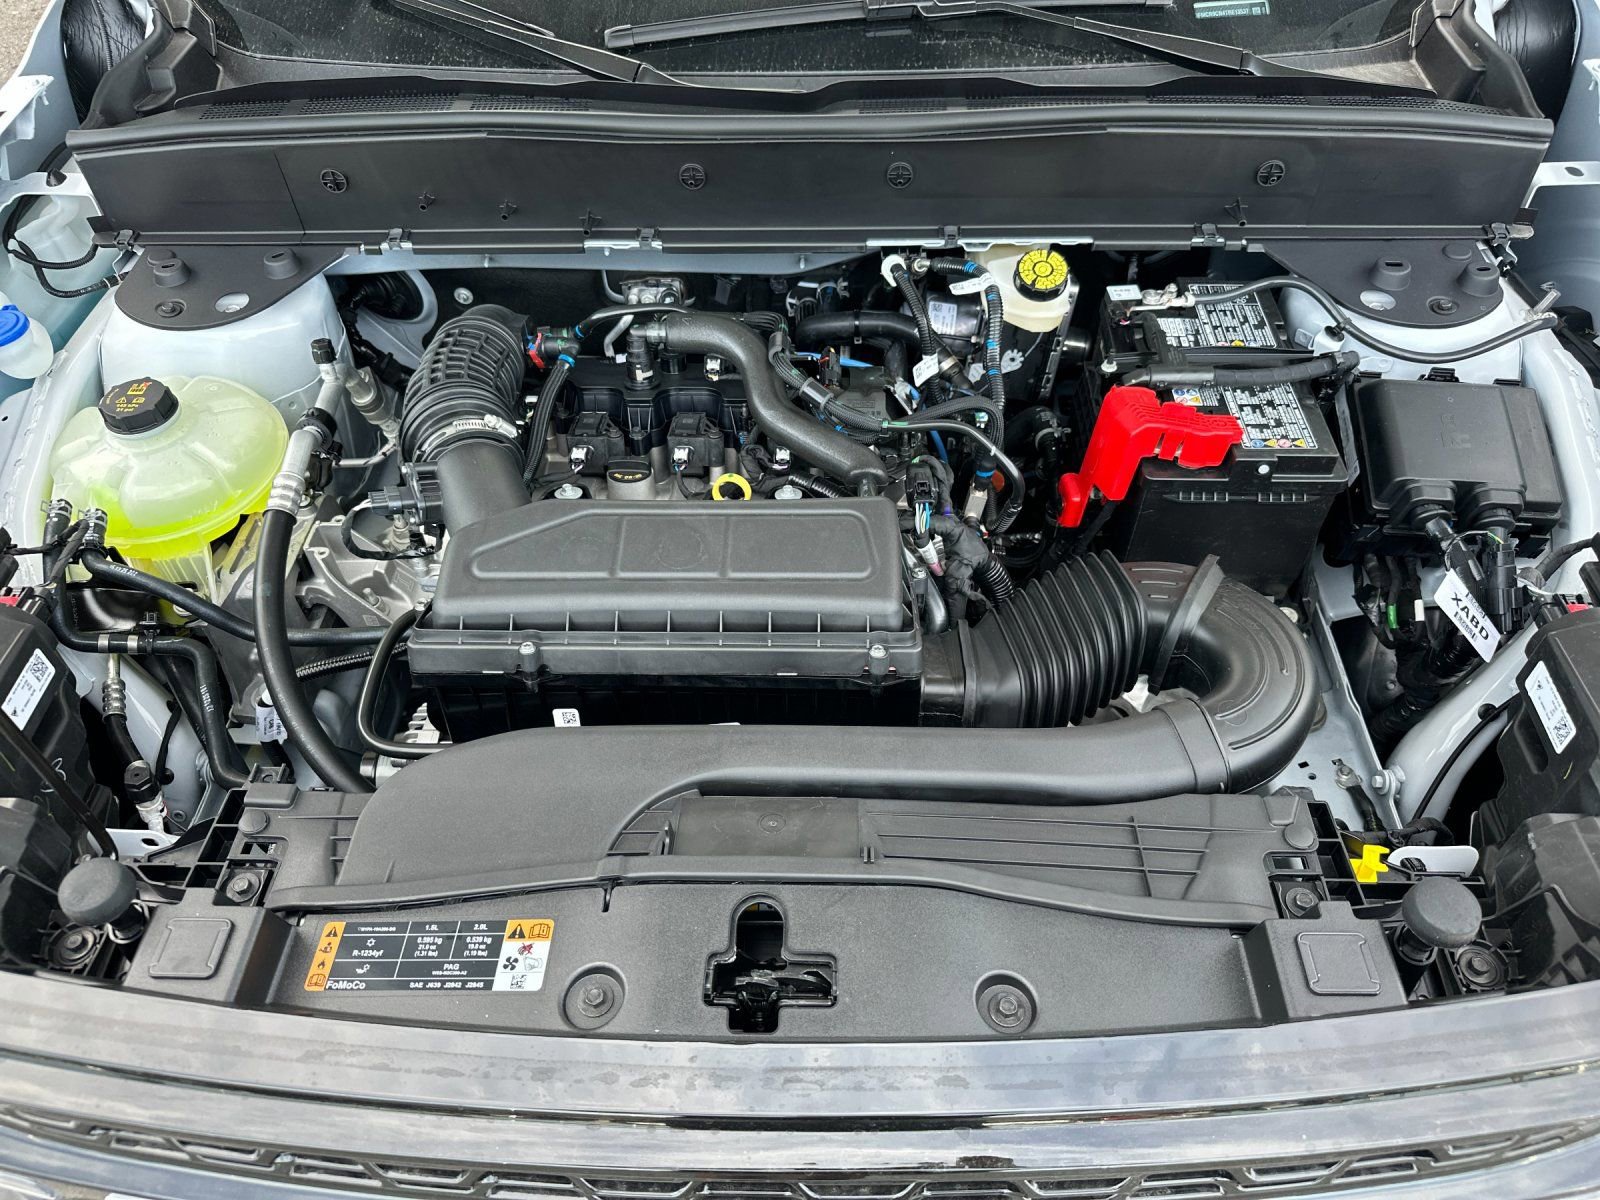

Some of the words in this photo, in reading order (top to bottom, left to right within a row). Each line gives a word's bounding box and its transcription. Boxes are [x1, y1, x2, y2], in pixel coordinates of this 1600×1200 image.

[1451, 592, 1489, 640] XABD
[473, 923, 488, 931] 2.0L
[434, 936, 443, 945] kg
[483, 936, 492, 945] kg
[352, 949, 384, 958] R-1234yf
[443, 963, 460, 971] PAG
[326, 980, 366, 990] FoMoCo
[426, 981, 442, 989] J639
